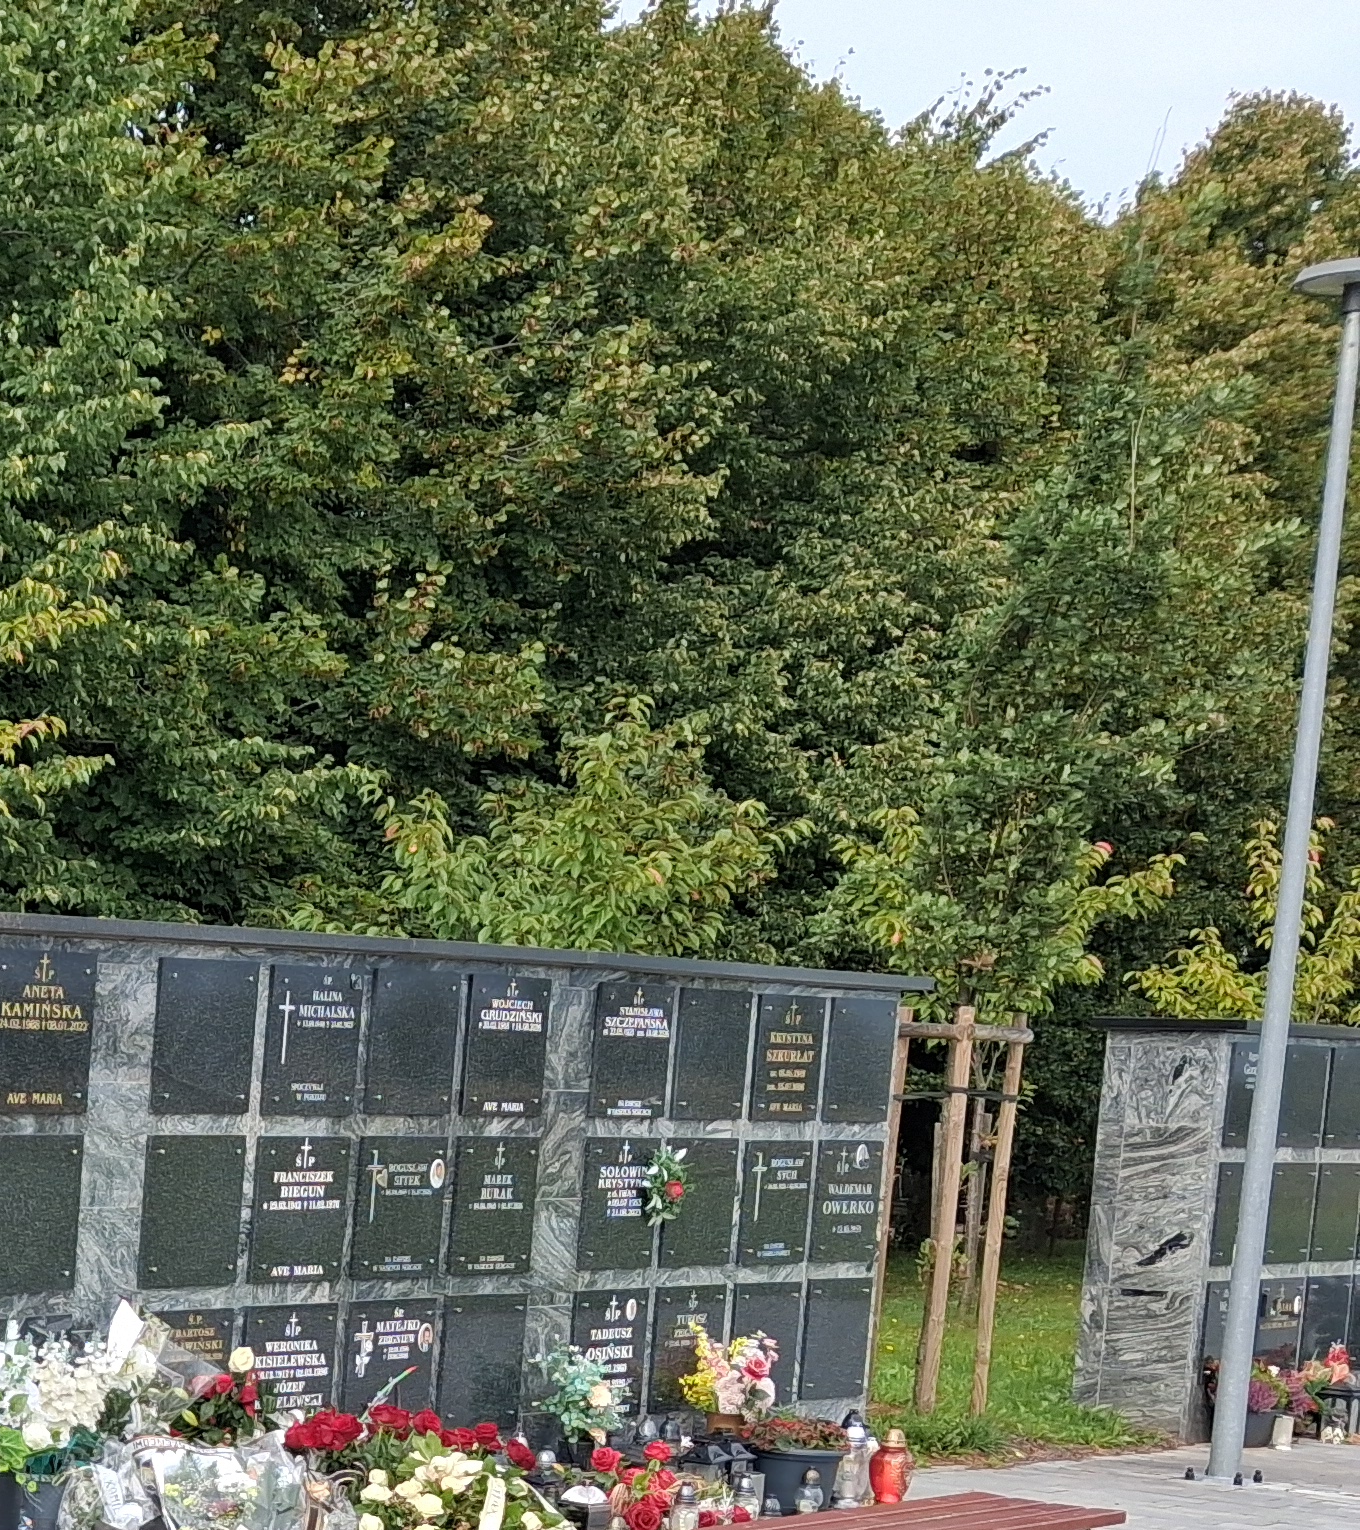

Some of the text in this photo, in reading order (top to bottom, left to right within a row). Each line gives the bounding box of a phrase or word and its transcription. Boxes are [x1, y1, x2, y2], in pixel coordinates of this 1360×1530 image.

[23, 984, 65, 999] ANETA
[299, 1004, 355, 1019] MICHALSKA
[6, 1092, 63, 1105] AVE MARIA
[273, 1171, 335, 1183] FRANCISZEK
[280, 1185, 326, 1198] BIEGUN
[822, 1200, 875, 1215] OWERKO
[270, 1265, 324, 1277] AVE MARIA
[590, 1327, 633, 1340] TADEUSZ
[265, 1340, 318, 1353] WERONIKA
[255, 1353, 326, 1369] KISIELEWSKA
[273, 1380, 306, 1394] JÓZEF
